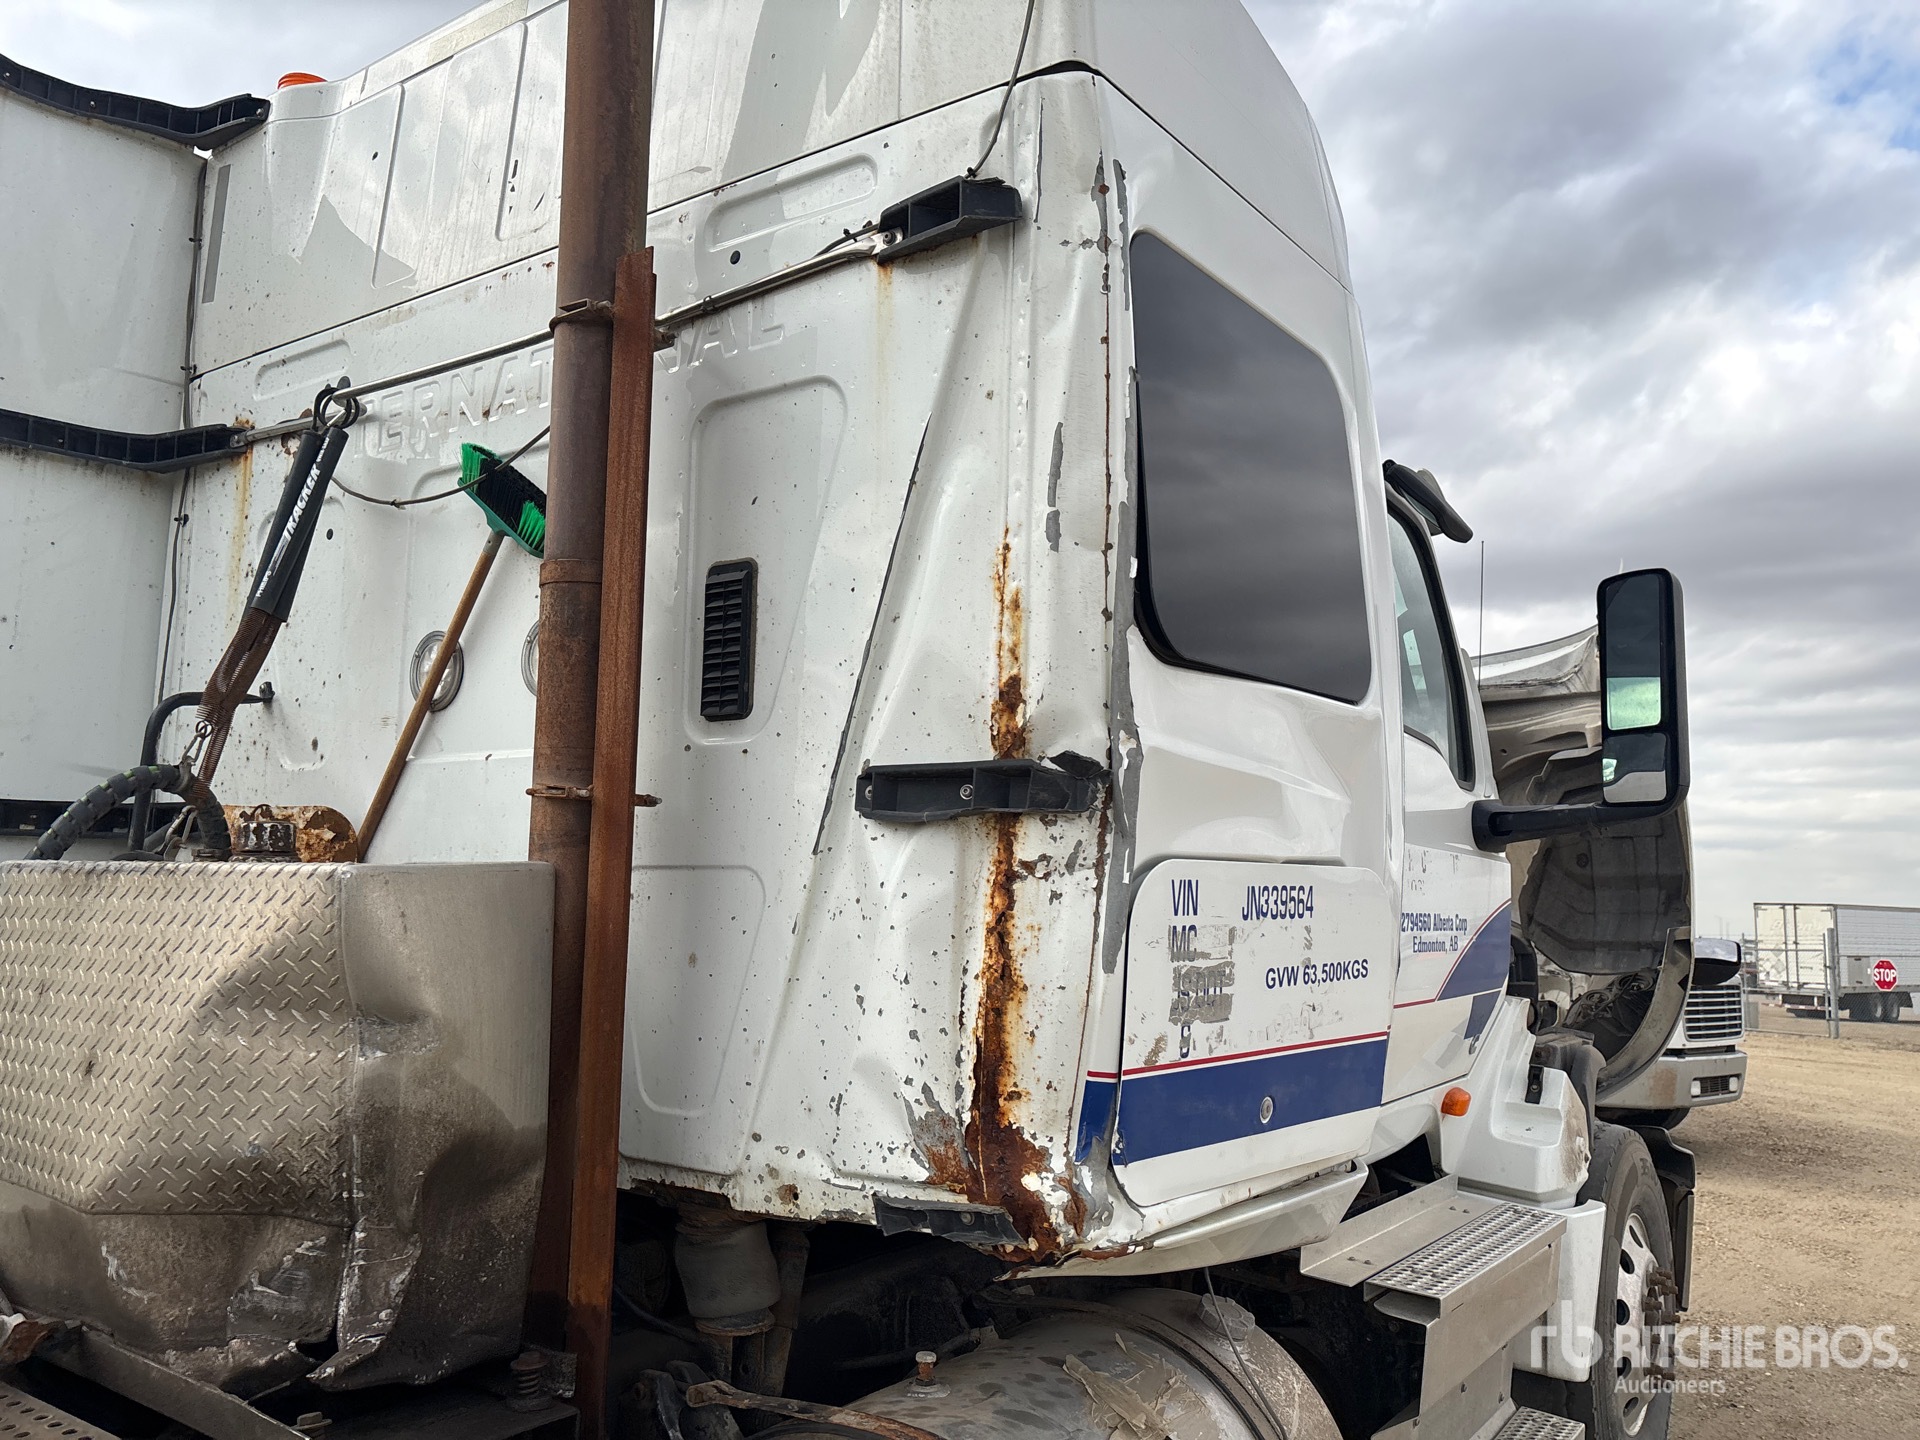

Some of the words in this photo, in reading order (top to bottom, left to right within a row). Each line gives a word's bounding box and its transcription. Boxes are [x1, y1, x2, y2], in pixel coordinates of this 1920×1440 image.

[283, 461, 321, 541] TRACKER
[1171, 879, 1199, 917] VIN
[1241, 885, 1314, 921] JN339564
[1401, 912, 1432, 932] 2794560
[1433, 913, 1454, 931] Alberta
[1455, 913, 1468, 935] Corp
[1412, 935, 1447, 954] Edmonton,
[1449, 935, 1459, 952] AB
[1265, 965, 1300, 989] GVW
[1303, 958, 1369, 987] 63,500KGS
[1873, 968, 1897, 982] STOP
